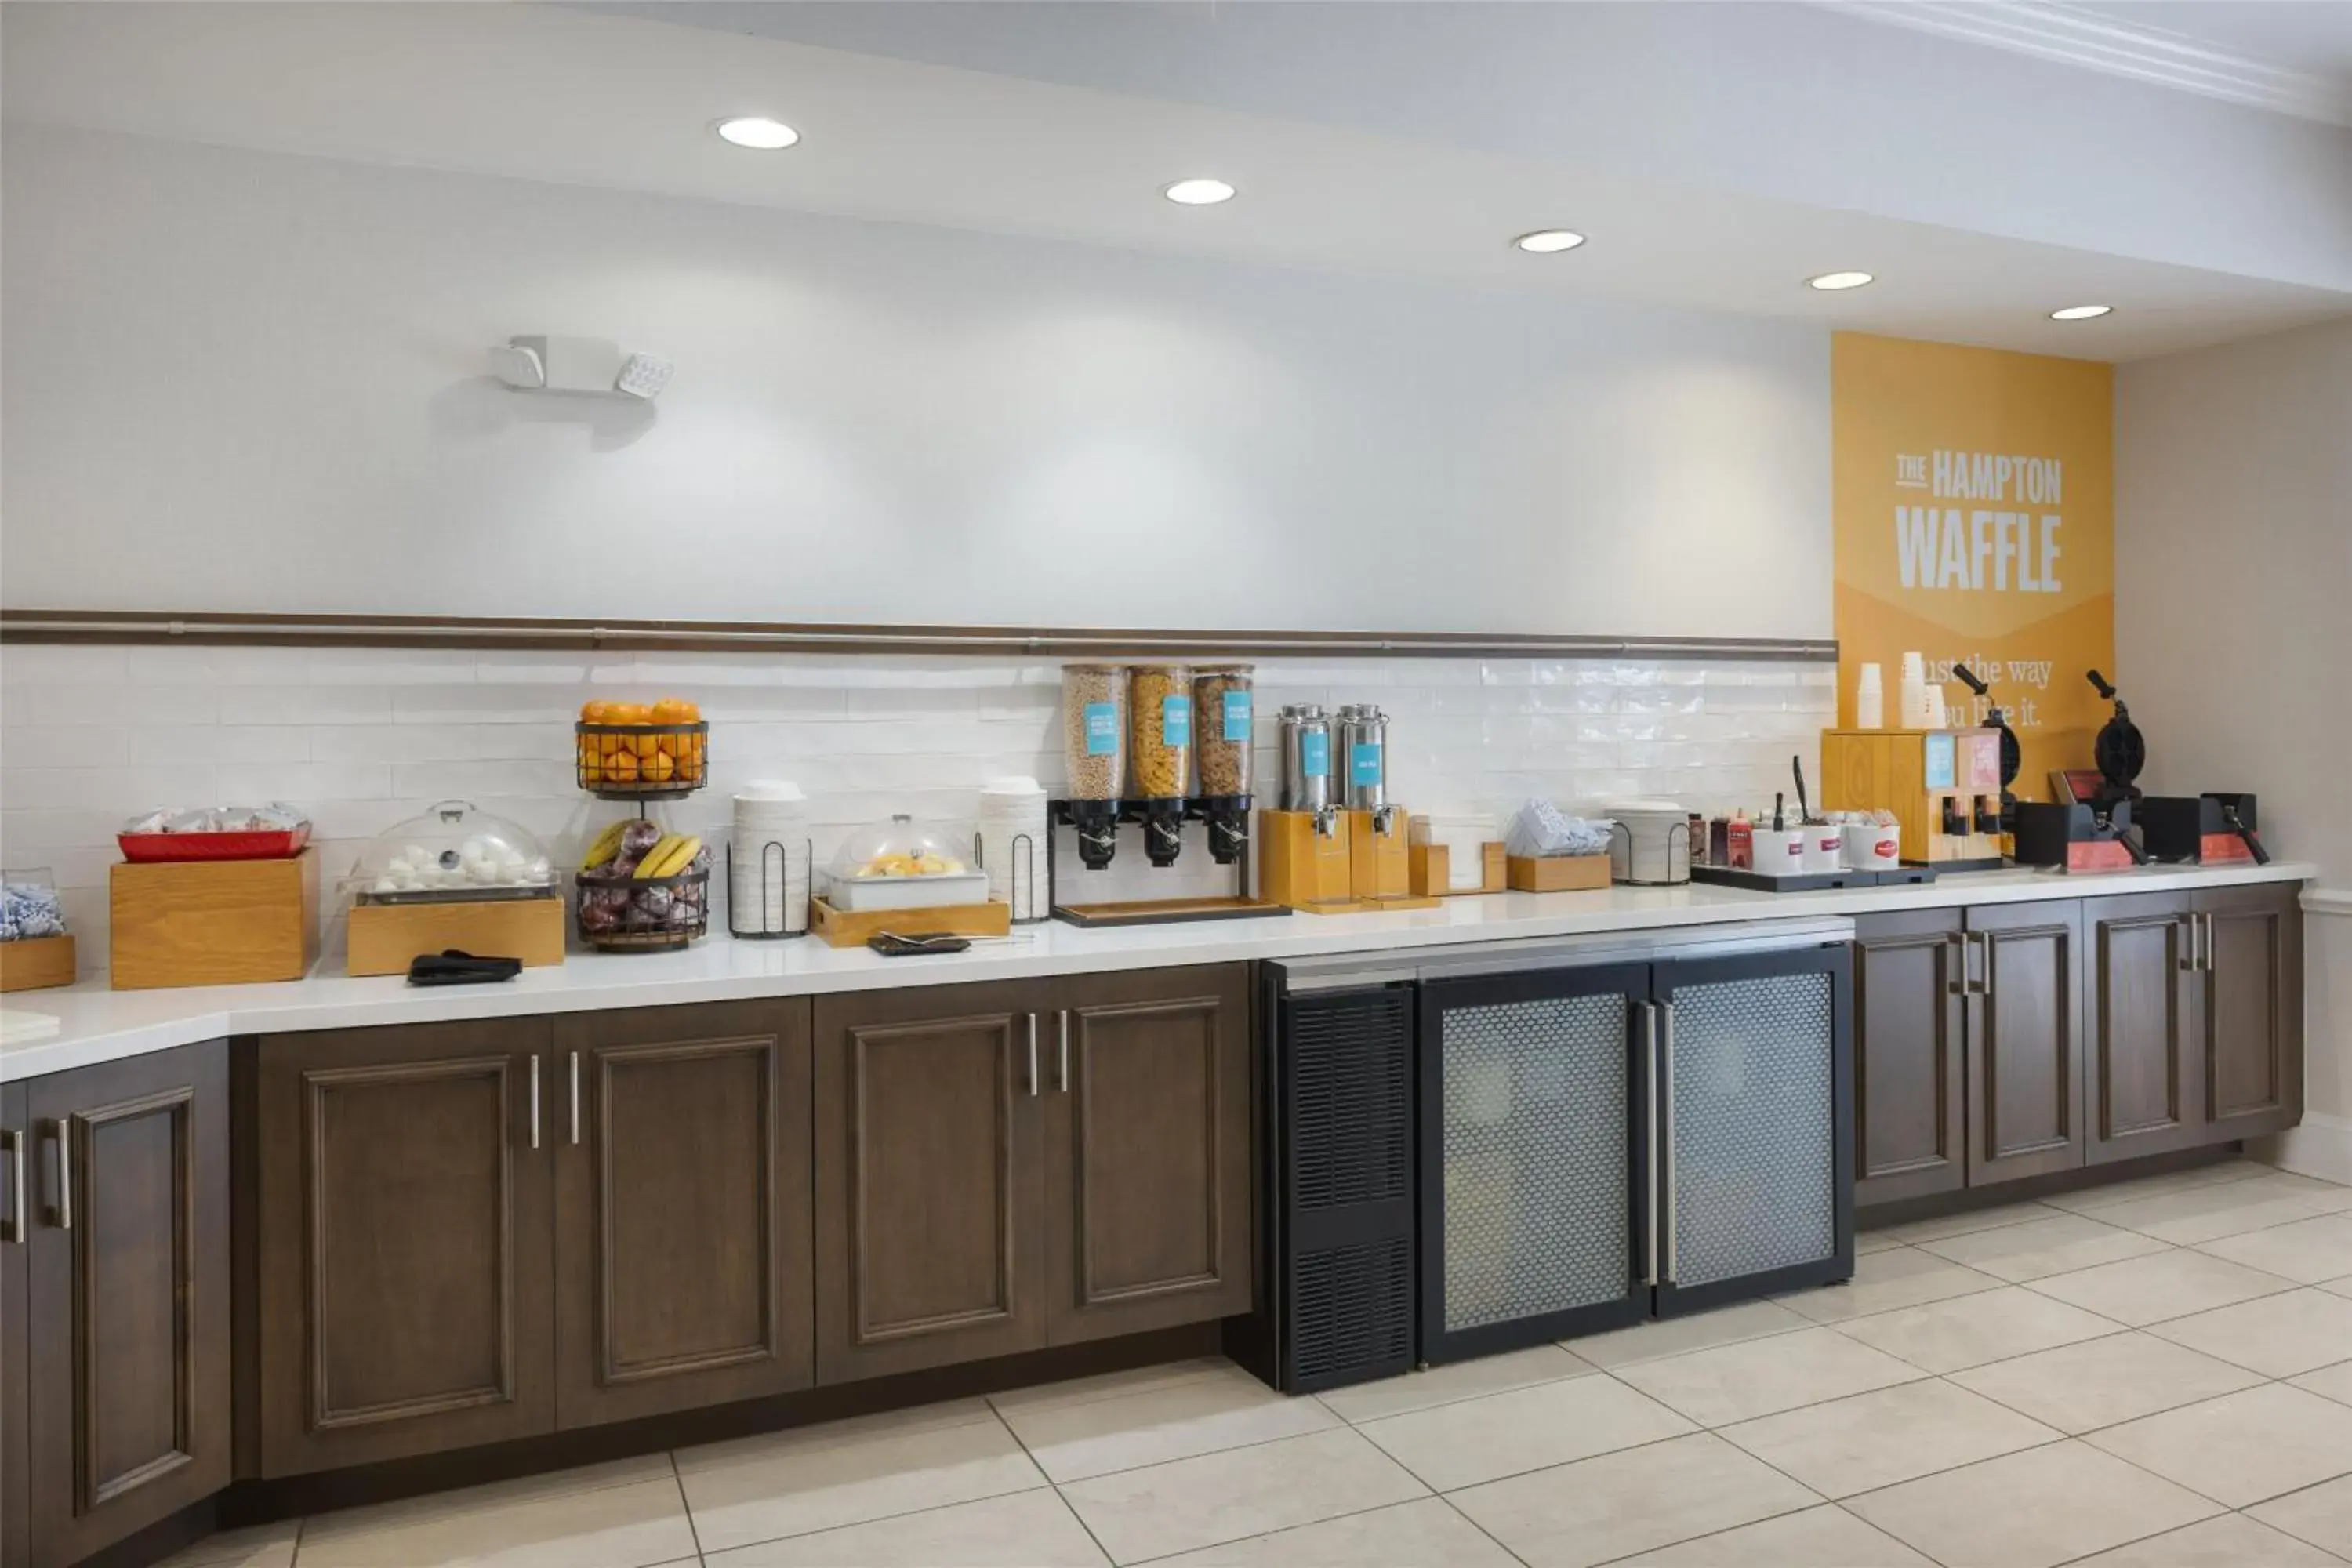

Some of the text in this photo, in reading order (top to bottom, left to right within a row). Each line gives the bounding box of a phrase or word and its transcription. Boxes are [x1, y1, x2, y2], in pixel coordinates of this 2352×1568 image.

[1896, 449, 2061, 504] THE HAMPTON
[1896, 506, 2062, 592] WAFFLE
[1921, 655, 1960, 682] ust
[2006, 660, 2052, 689] way
[1971, 697, 2015, 727] lie
[2021, 697, 2041, 726] it.
